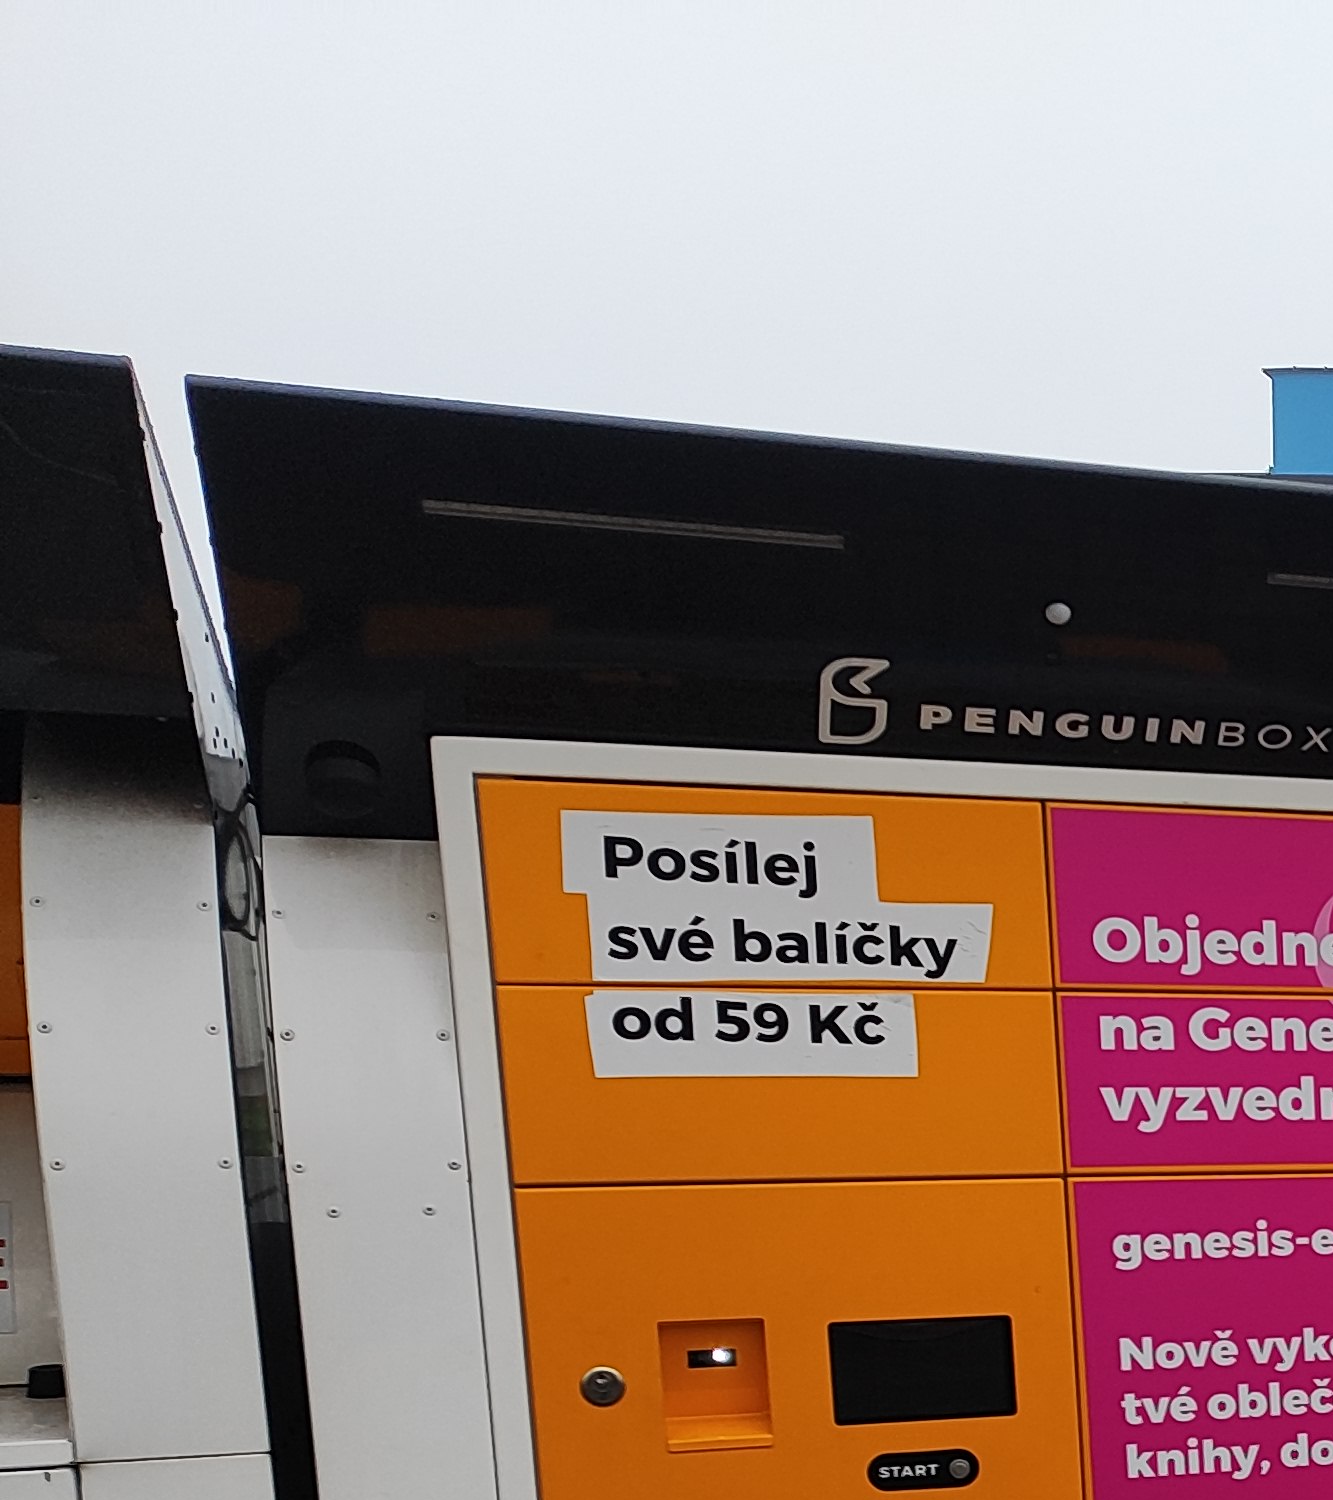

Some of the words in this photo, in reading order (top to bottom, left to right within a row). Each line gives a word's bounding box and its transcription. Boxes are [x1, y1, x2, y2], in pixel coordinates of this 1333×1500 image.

[919, 704, 1332, 752] PENGUINBOX
[602, 836, 818, 899] Posílej
[607, 916, 714, 962] své
[733, 919, 957, 979] balíčky
[612, 997, 694, 1041] od
[715, 1002, 788, 1043] 59
[809, 1002, 885, 1045] Kč
[1100, 1013, 1174, 1051] na
[1119, 1330, 1239, 1370] Nově
[1120, 1386, 1197, 1424] tvé
[879, 1464, 940, 1478] START
[1126, 1437, 1271, 1479] knihy,
